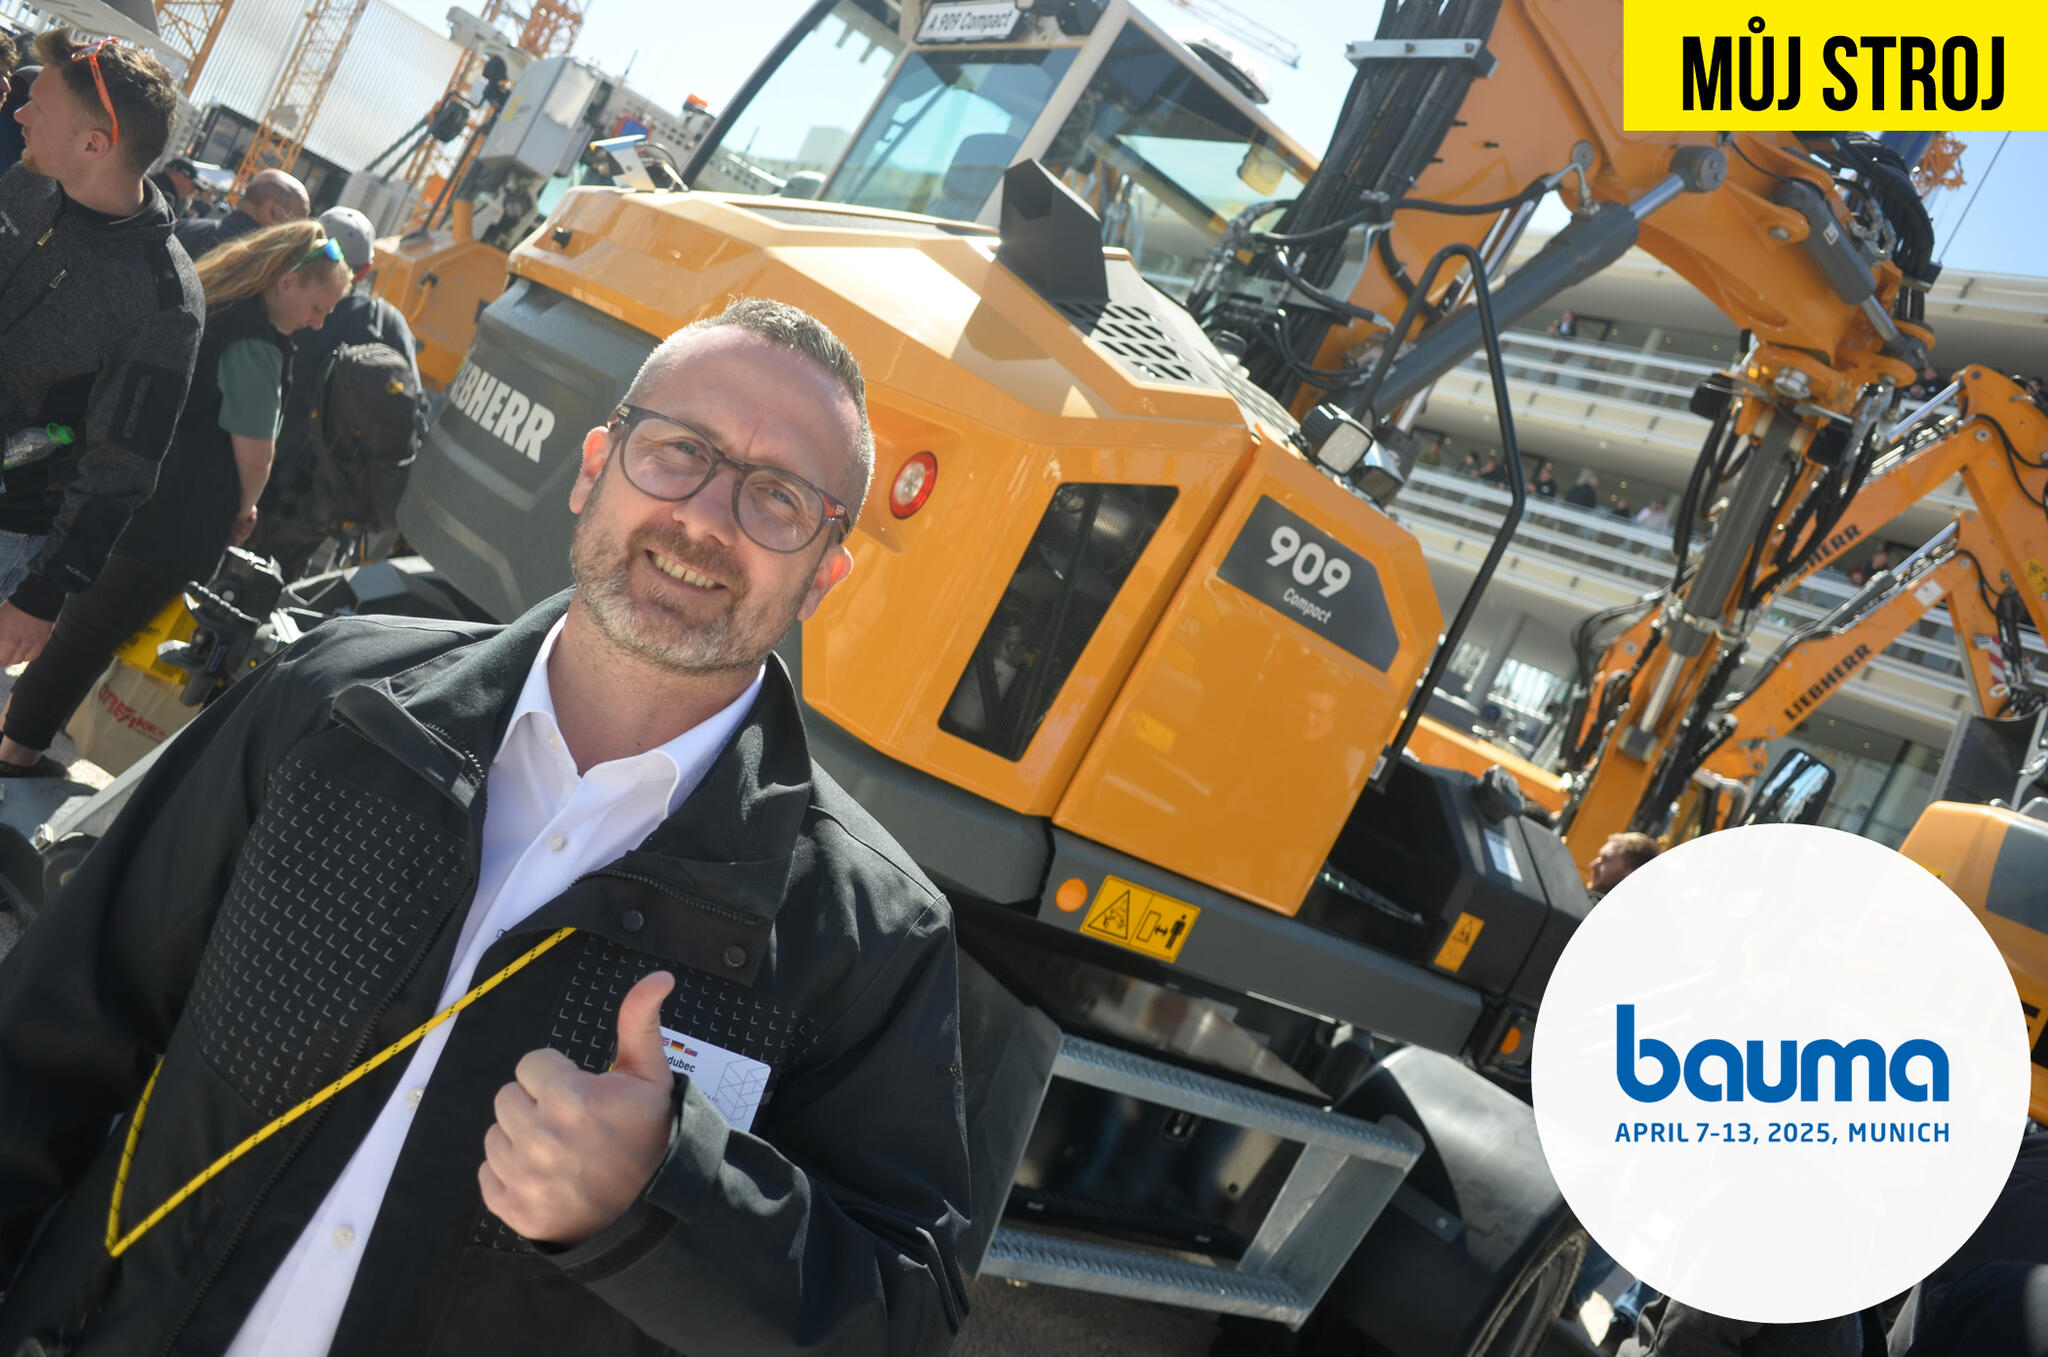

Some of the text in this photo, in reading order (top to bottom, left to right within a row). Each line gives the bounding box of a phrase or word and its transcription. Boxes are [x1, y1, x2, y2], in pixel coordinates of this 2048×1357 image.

[961, 9, 1013, 32] Compact
[1266, 525, 1351, 598] 909
[1283, 587, 1332, 624] Compact
[1784, 642, 1870, 720] LIEBHERR
[666, 1055, 696, 1073] dubec
